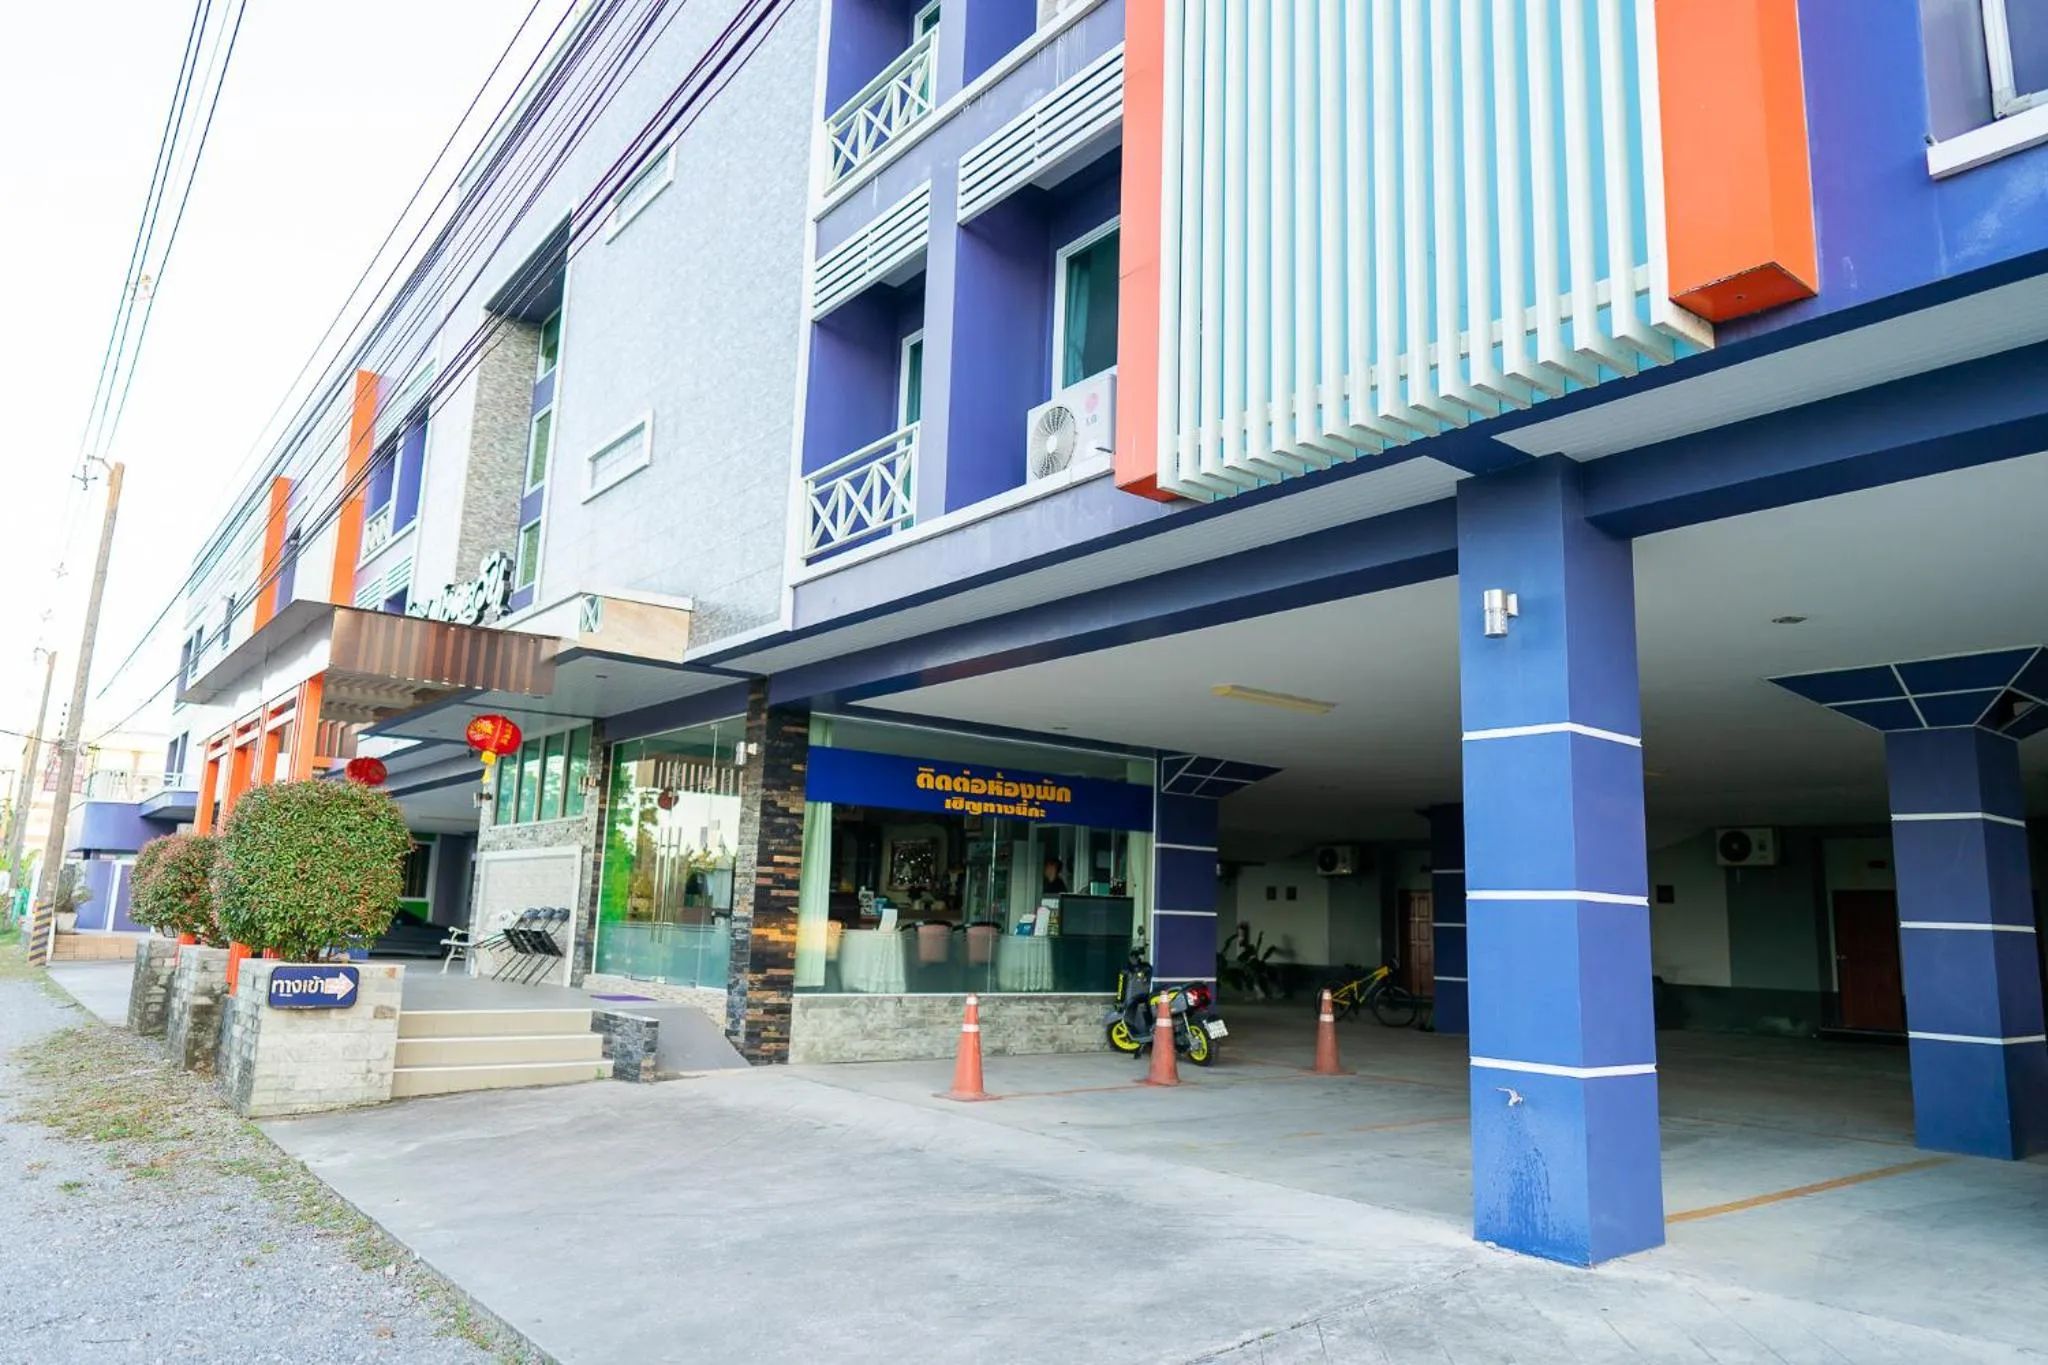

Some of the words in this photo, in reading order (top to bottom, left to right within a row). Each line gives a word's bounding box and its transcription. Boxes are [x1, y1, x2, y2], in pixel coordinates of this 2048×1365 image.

[916, 767, 1072, 803] ติดต่อห้องพัก
[271, 975, 325, 994] ทางเข้า
